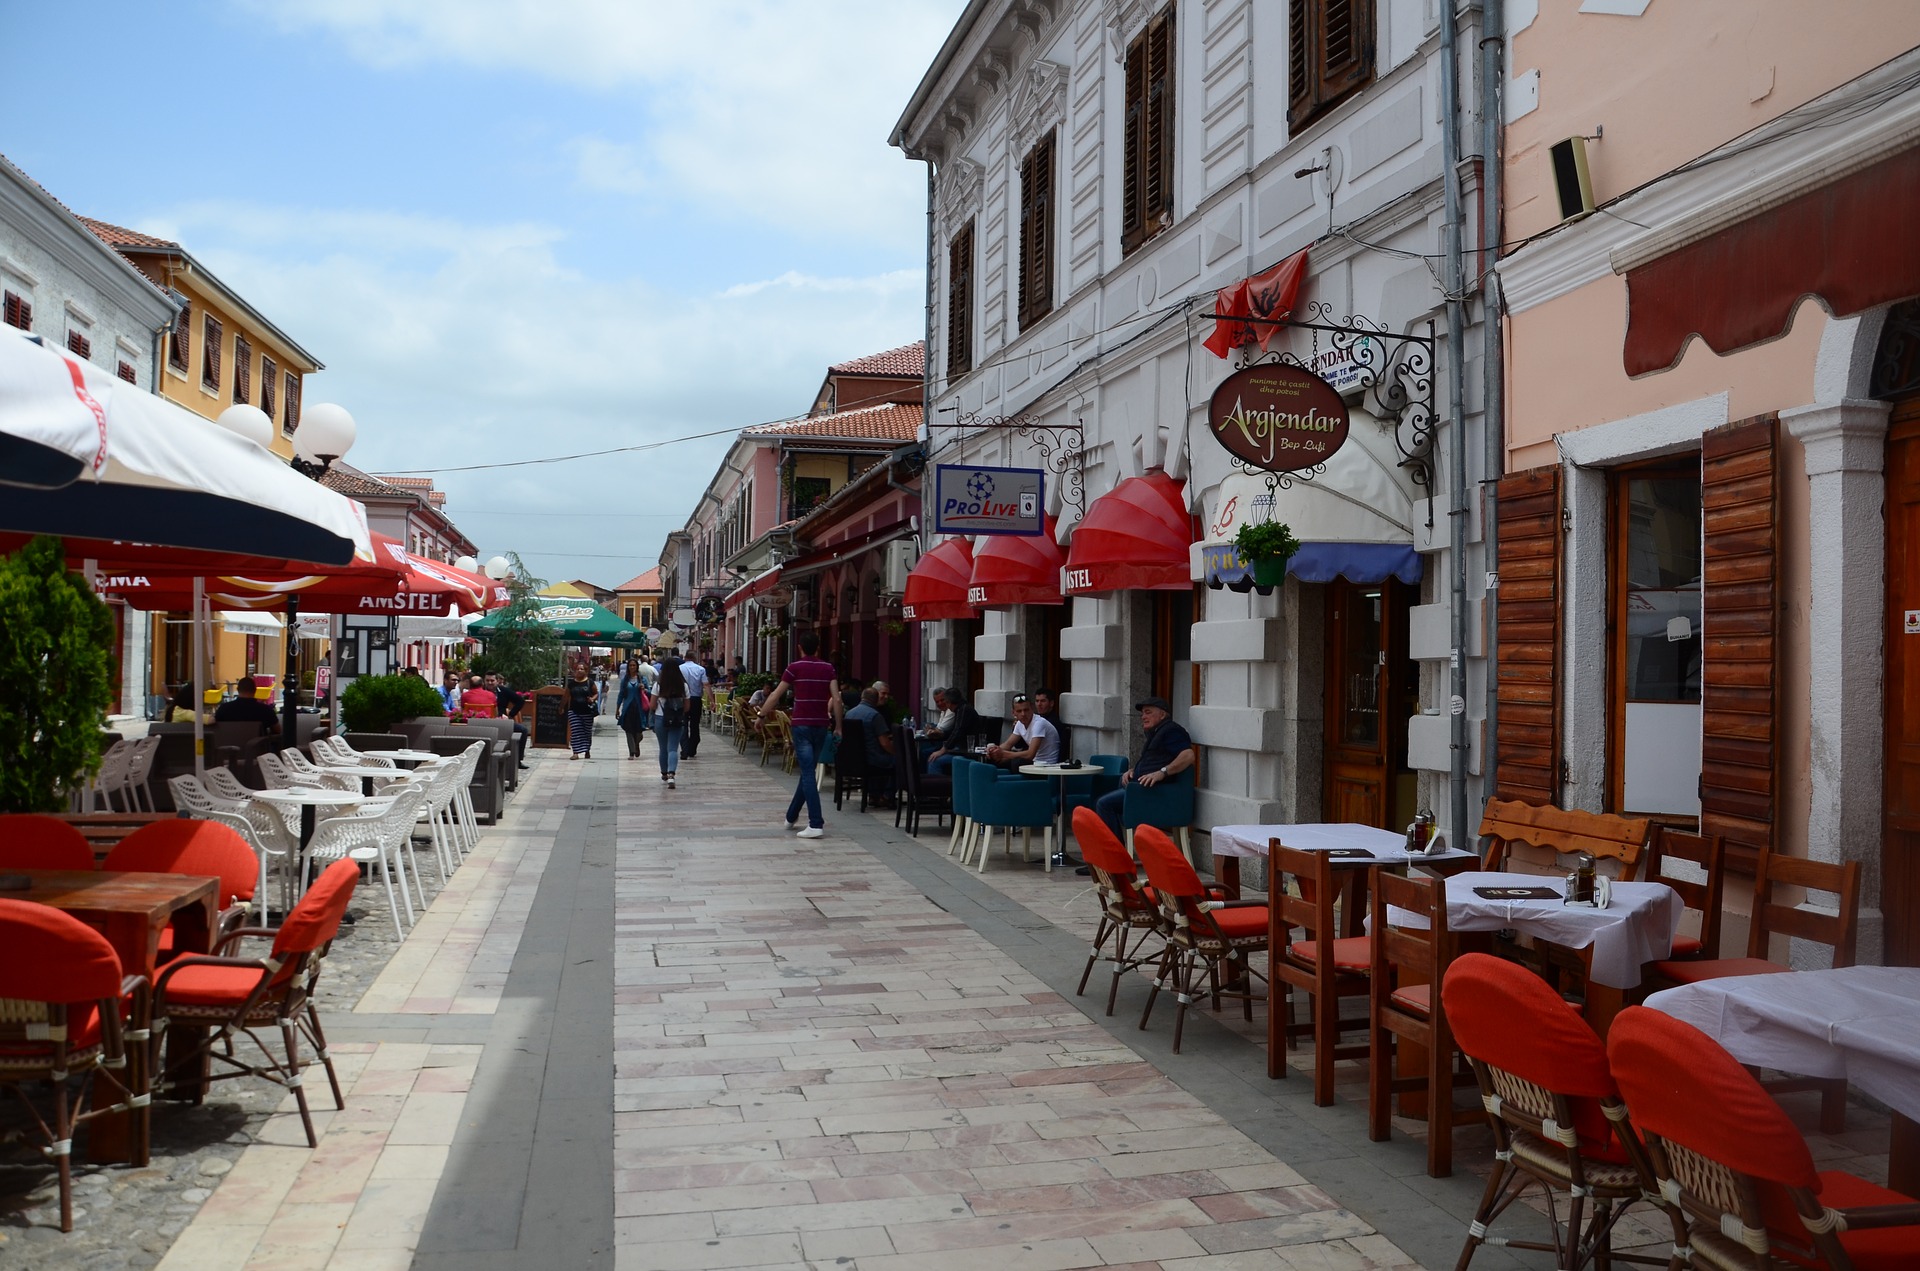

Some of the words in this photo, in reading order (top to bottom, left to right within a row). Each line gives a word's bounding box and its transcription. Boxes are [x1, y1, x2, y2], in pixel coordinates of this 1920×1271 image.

[1249, 378, 1277, 386] punime
[1288, 381, 1311, 389] çastit
[1260, 385, 1275, 394] dhe
[1276, 388, 1300, 396] porosi
[1218, 394, 1341, 464] Argjendar
[1280, 437, 1300, 451] Bep
[358, 592, 442, 610] AMSTEL
[303, 617, 329, 625] Spring
